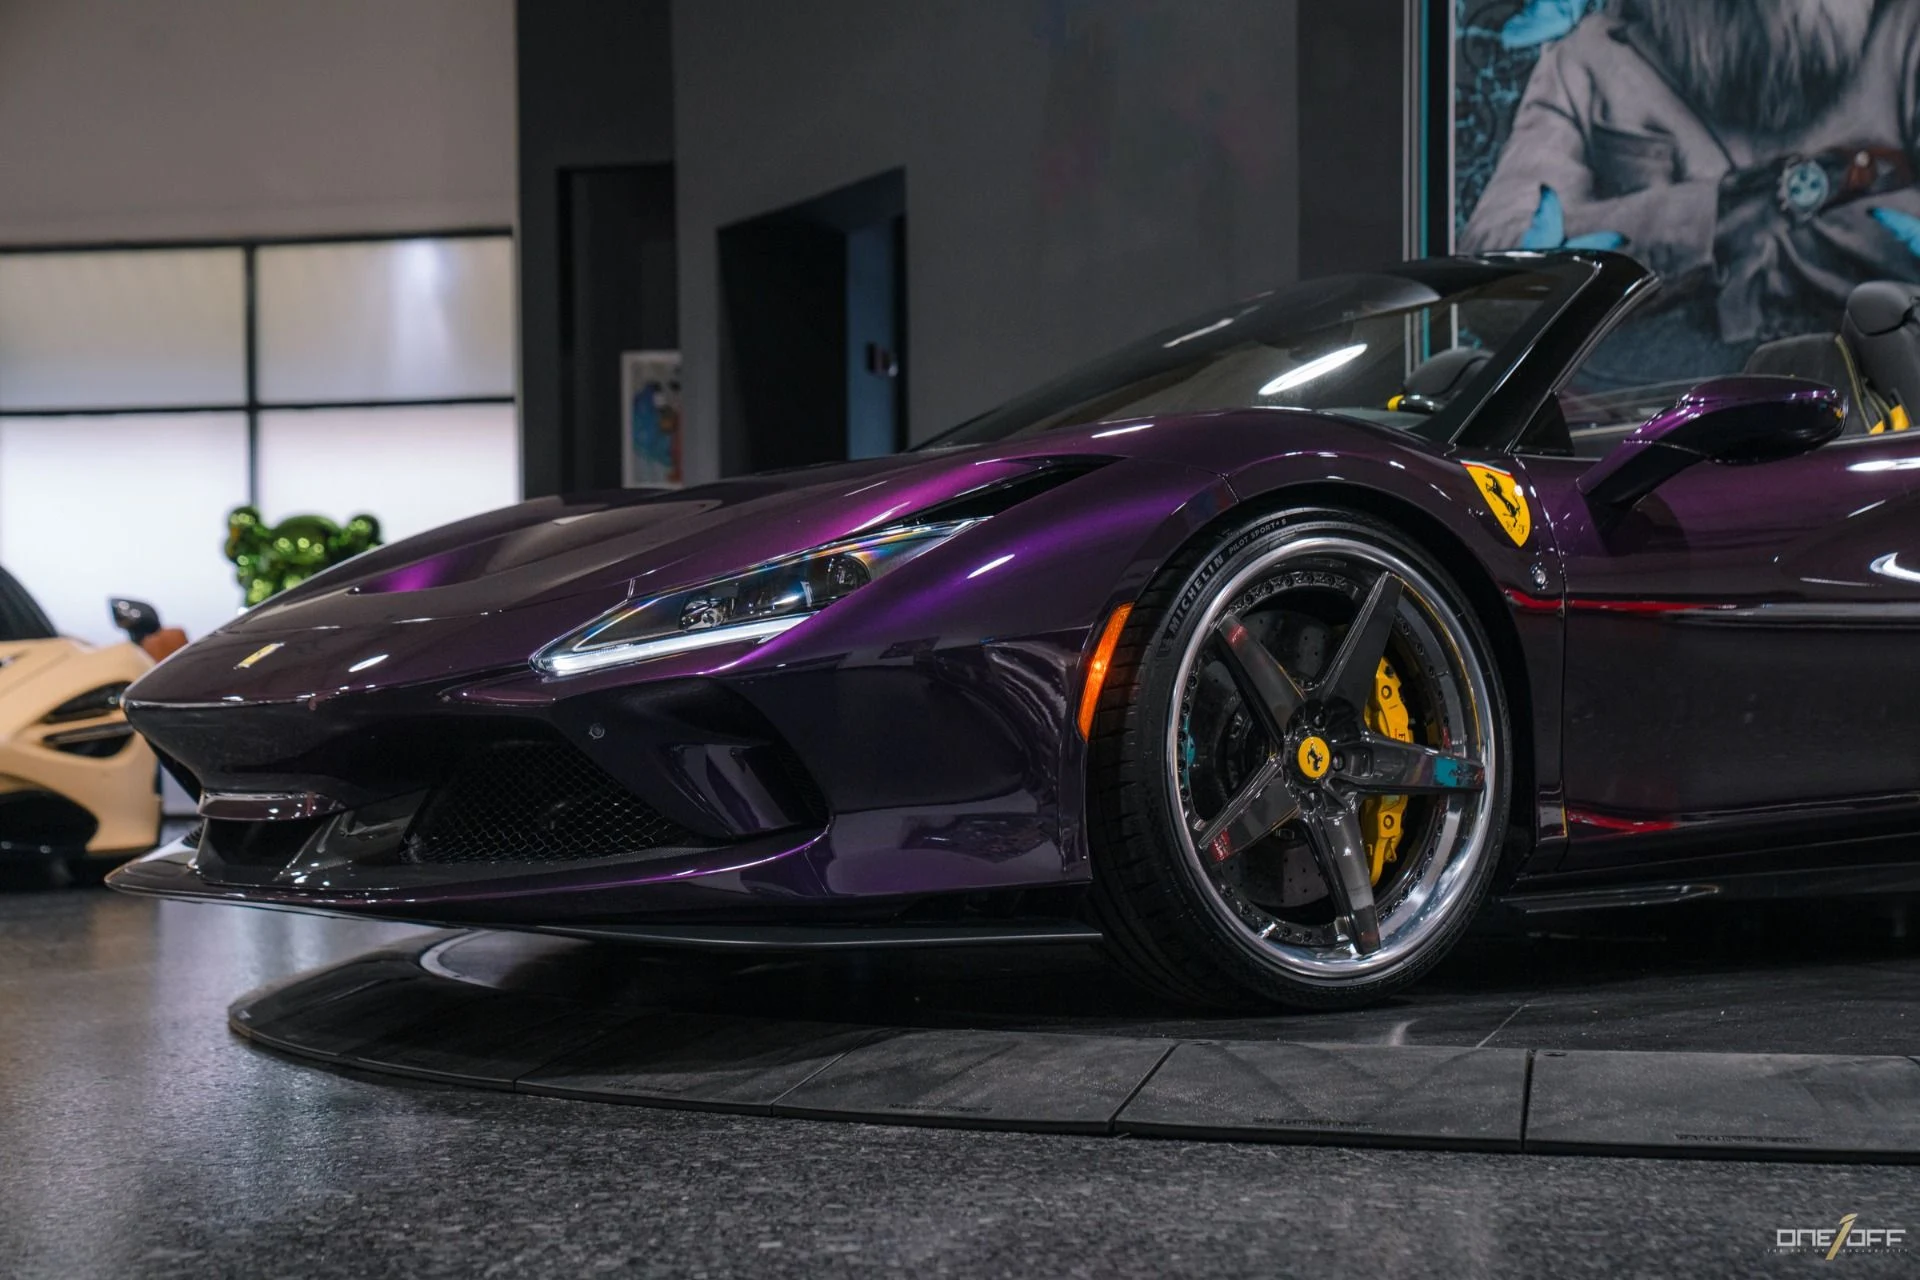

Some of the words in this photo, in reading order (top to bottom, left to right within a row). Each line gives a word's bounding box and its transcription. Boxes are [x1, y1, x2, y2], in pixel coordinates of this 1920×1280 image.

[1168, 555, 1224, 633] MICHELIN
[1229, 536, 1248, 554] PILOT
[1251, 522, 1275, 539] SPORT
